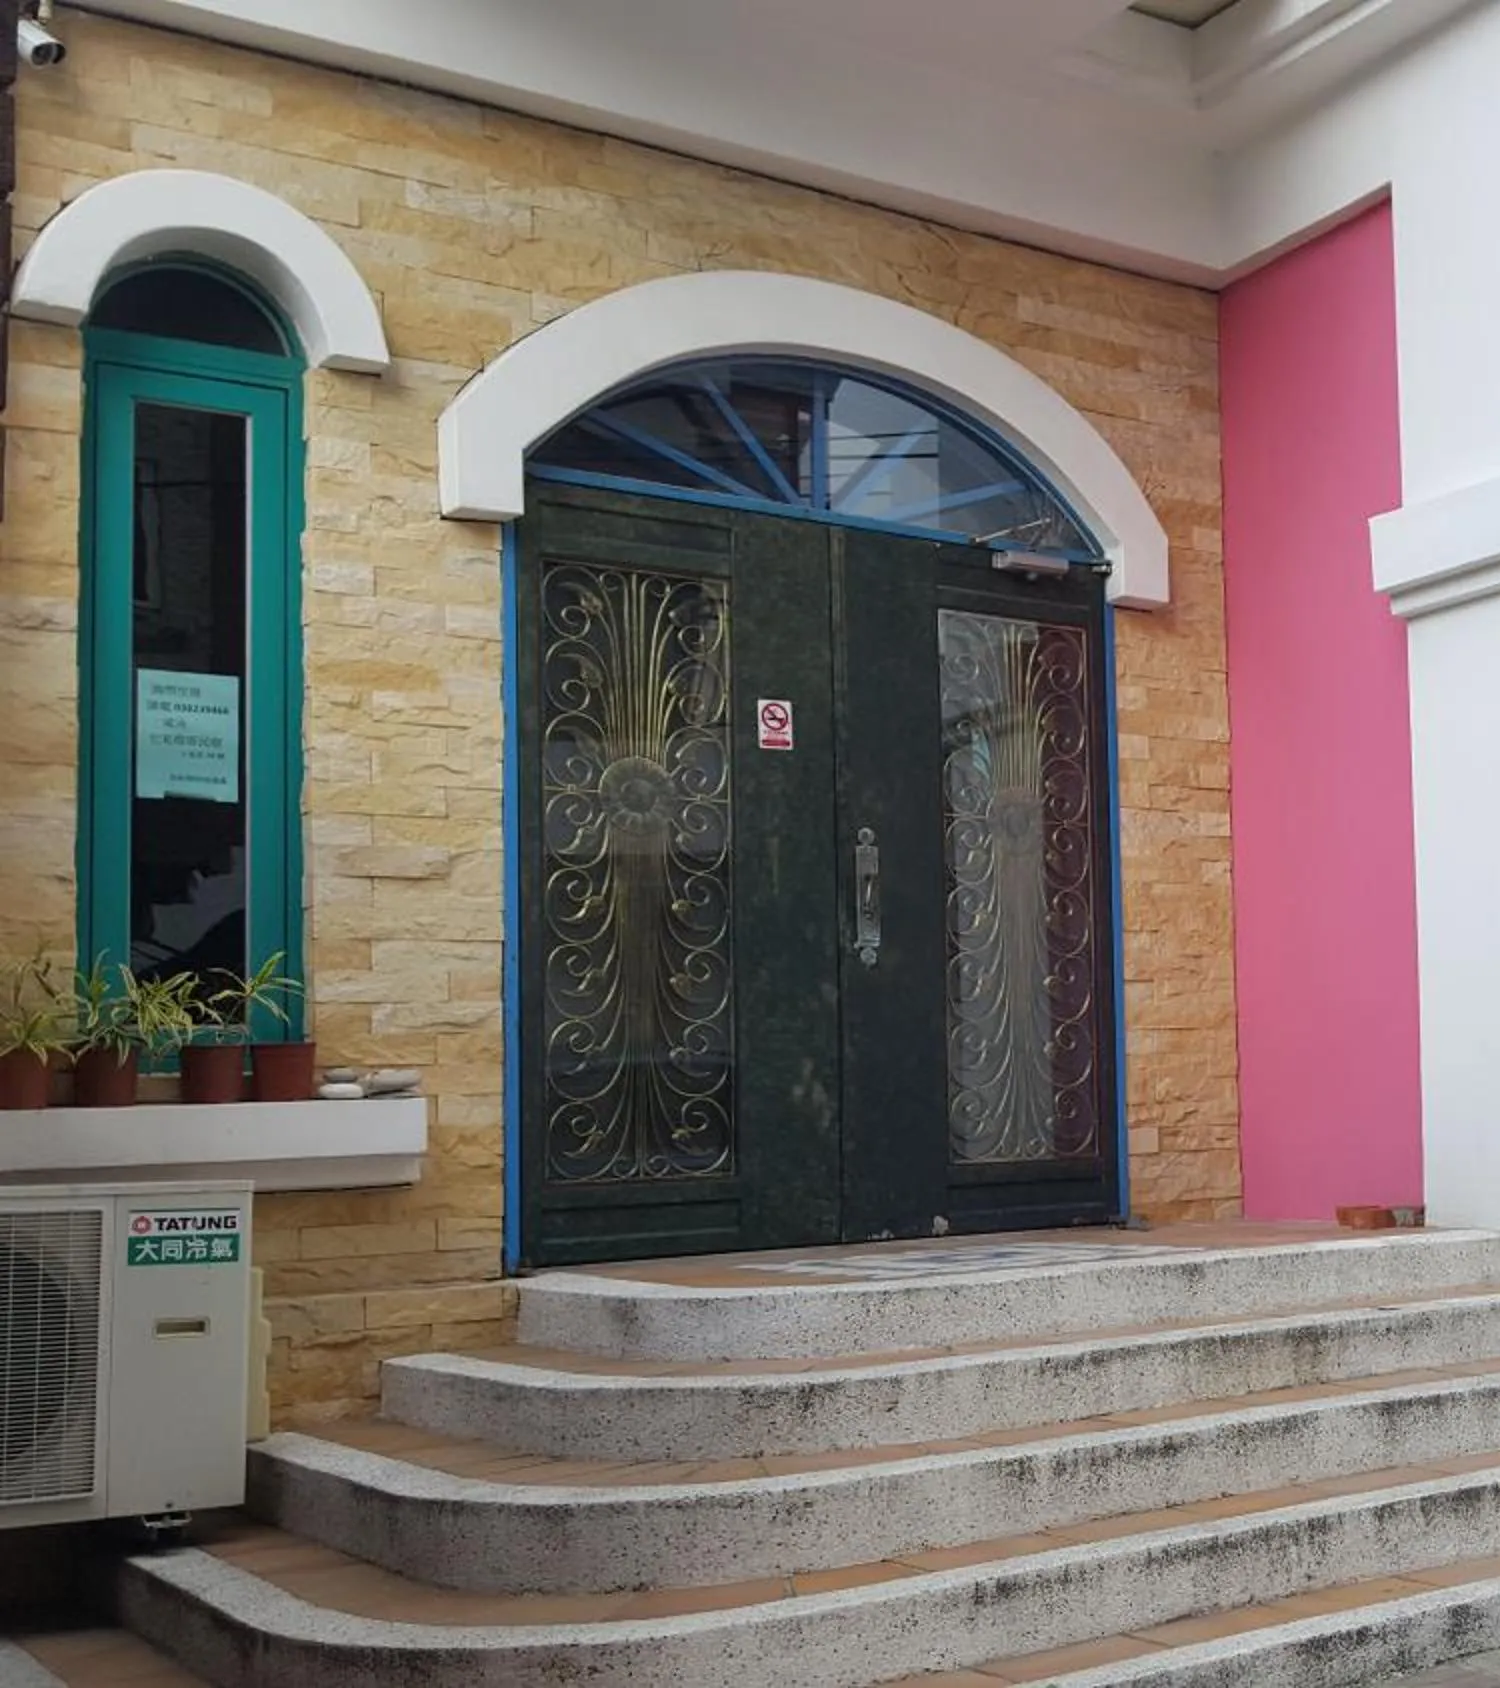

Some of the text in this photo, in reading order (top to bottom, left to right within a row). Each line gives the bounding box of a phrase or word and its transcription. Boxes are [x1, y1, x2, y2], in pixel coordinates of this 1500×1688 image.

[154, 1215, 237, 1231] TATUNG
[135, 1236, 233, 1262] 大同冷氣
